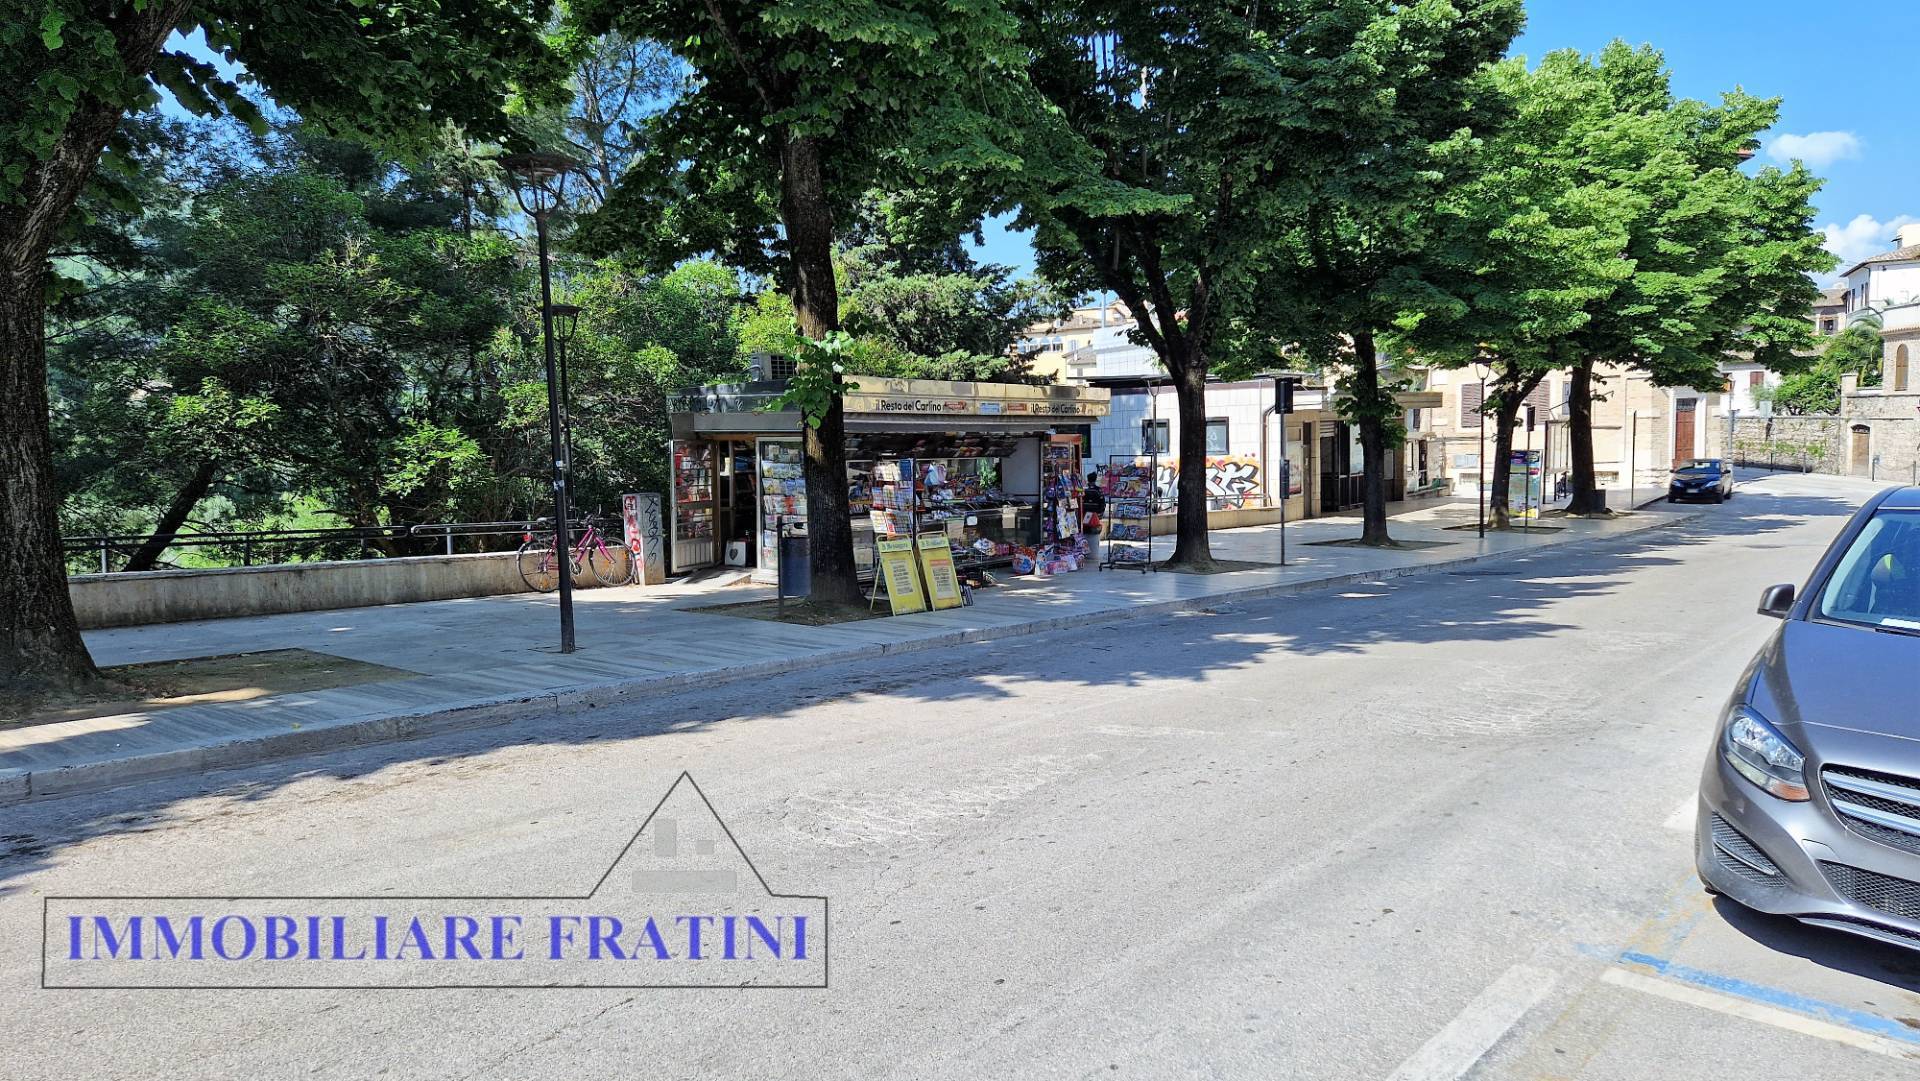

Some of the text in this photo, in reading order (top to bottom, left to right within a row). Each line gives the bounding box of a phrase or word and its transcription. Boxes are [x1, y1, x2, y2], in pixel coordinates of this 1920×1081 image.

[881, 400, 902, 411] Resto
[903, 401, 914, 411] del
[915, 400, 942, 412] Carlino
[1035, 403, 1051, 413] Resto
[1052, 403, 1060, 413] del
[1061, 404, 1081, 414] Carlino
